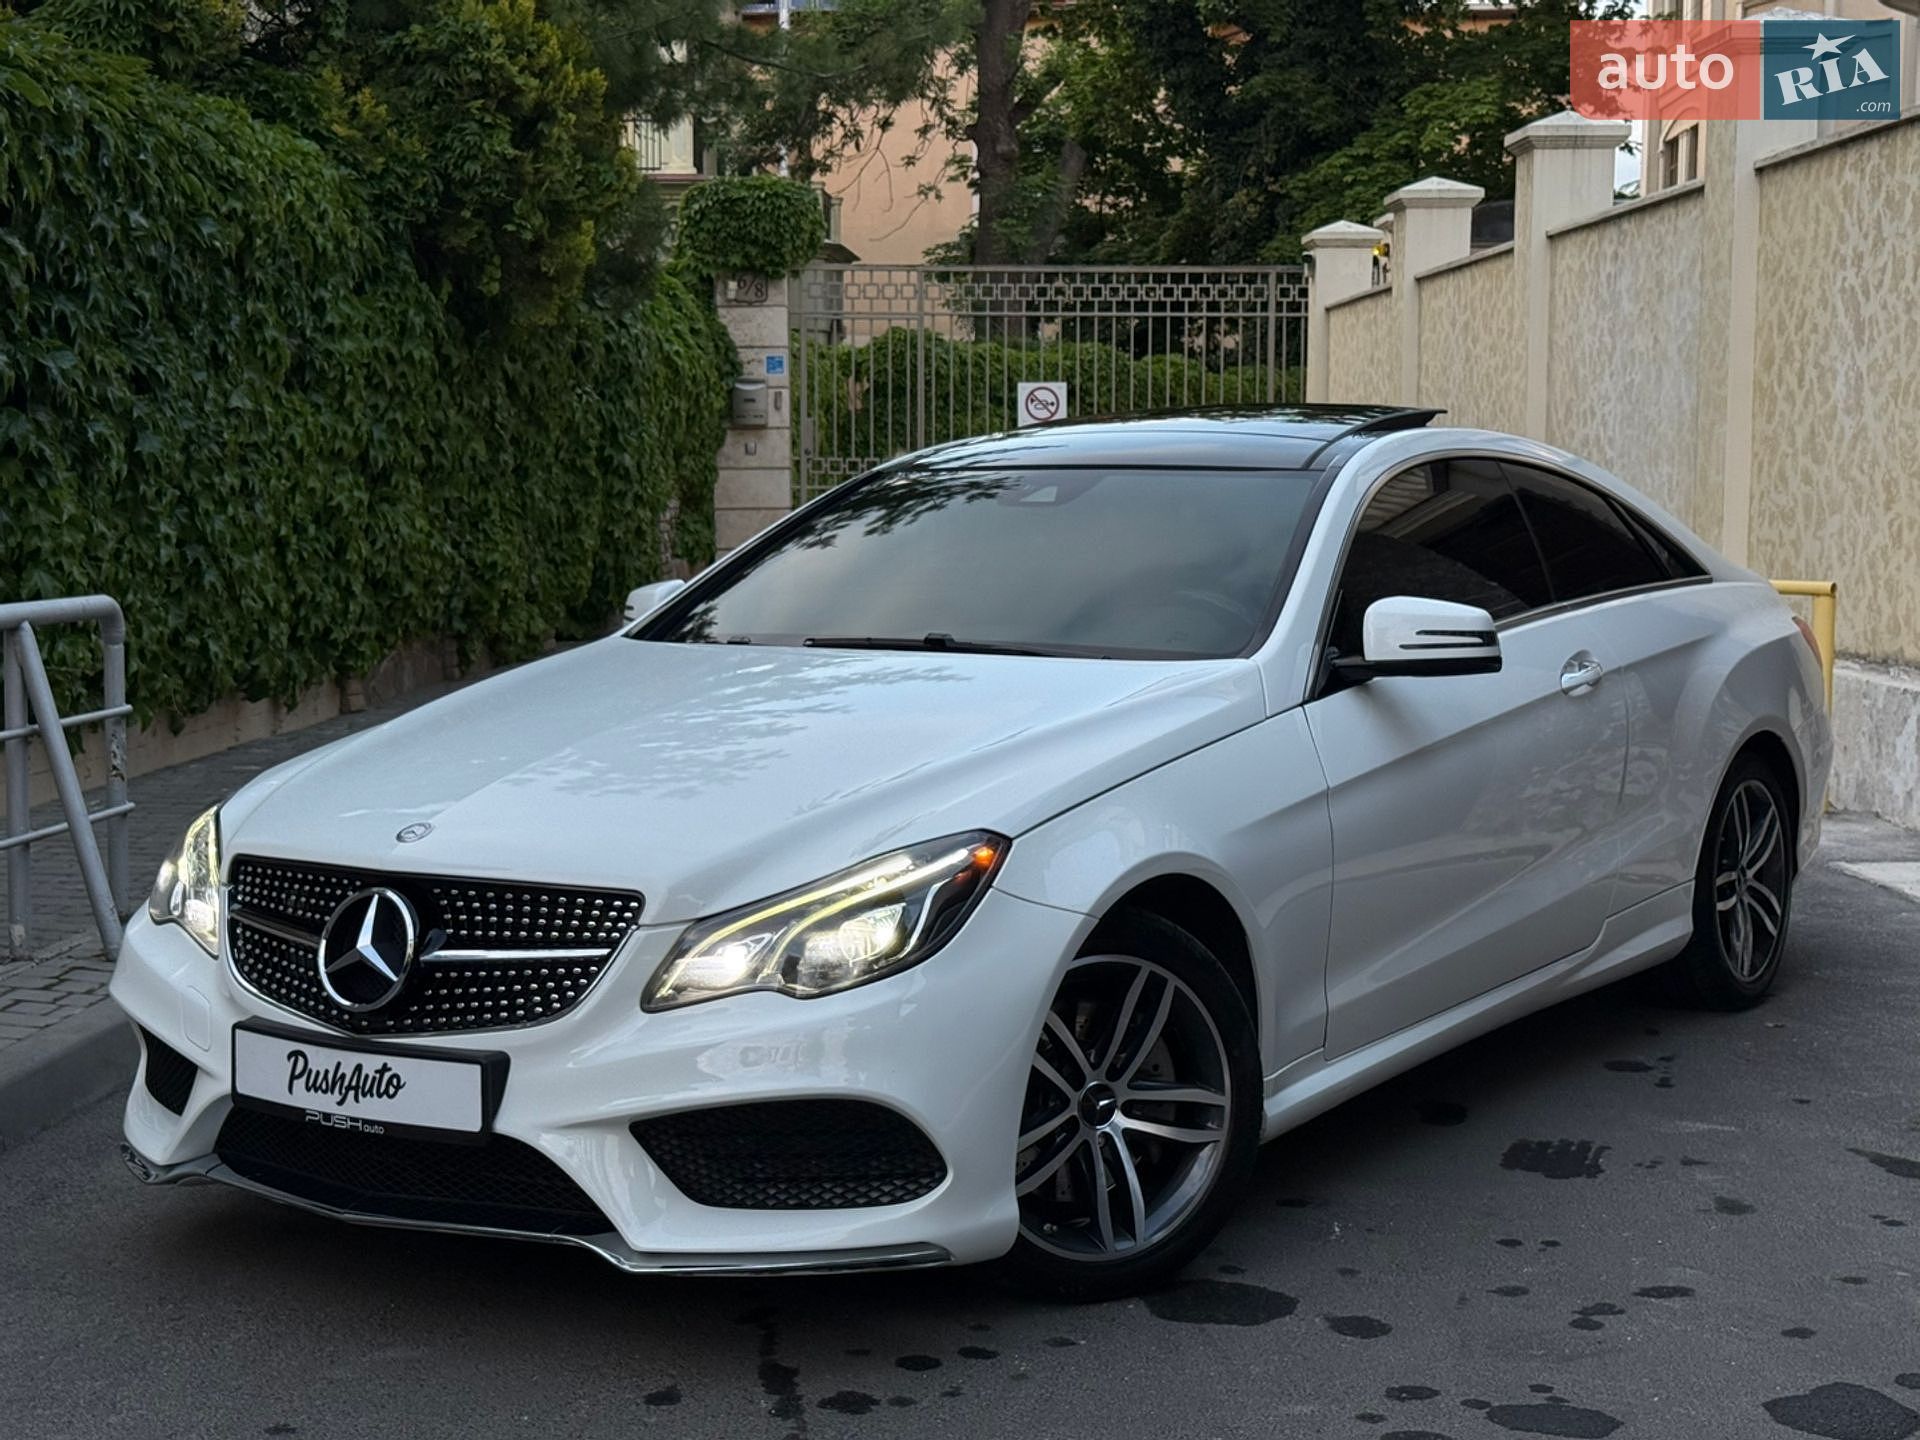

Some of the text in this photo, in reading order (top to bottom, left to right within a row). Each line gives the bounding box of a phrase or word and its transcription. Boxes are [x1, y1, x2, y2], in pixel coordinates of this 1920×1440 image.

[287, 1049, 406, 1106] PushAuto
[305, 1109, 385, 1135] PUSH auto
